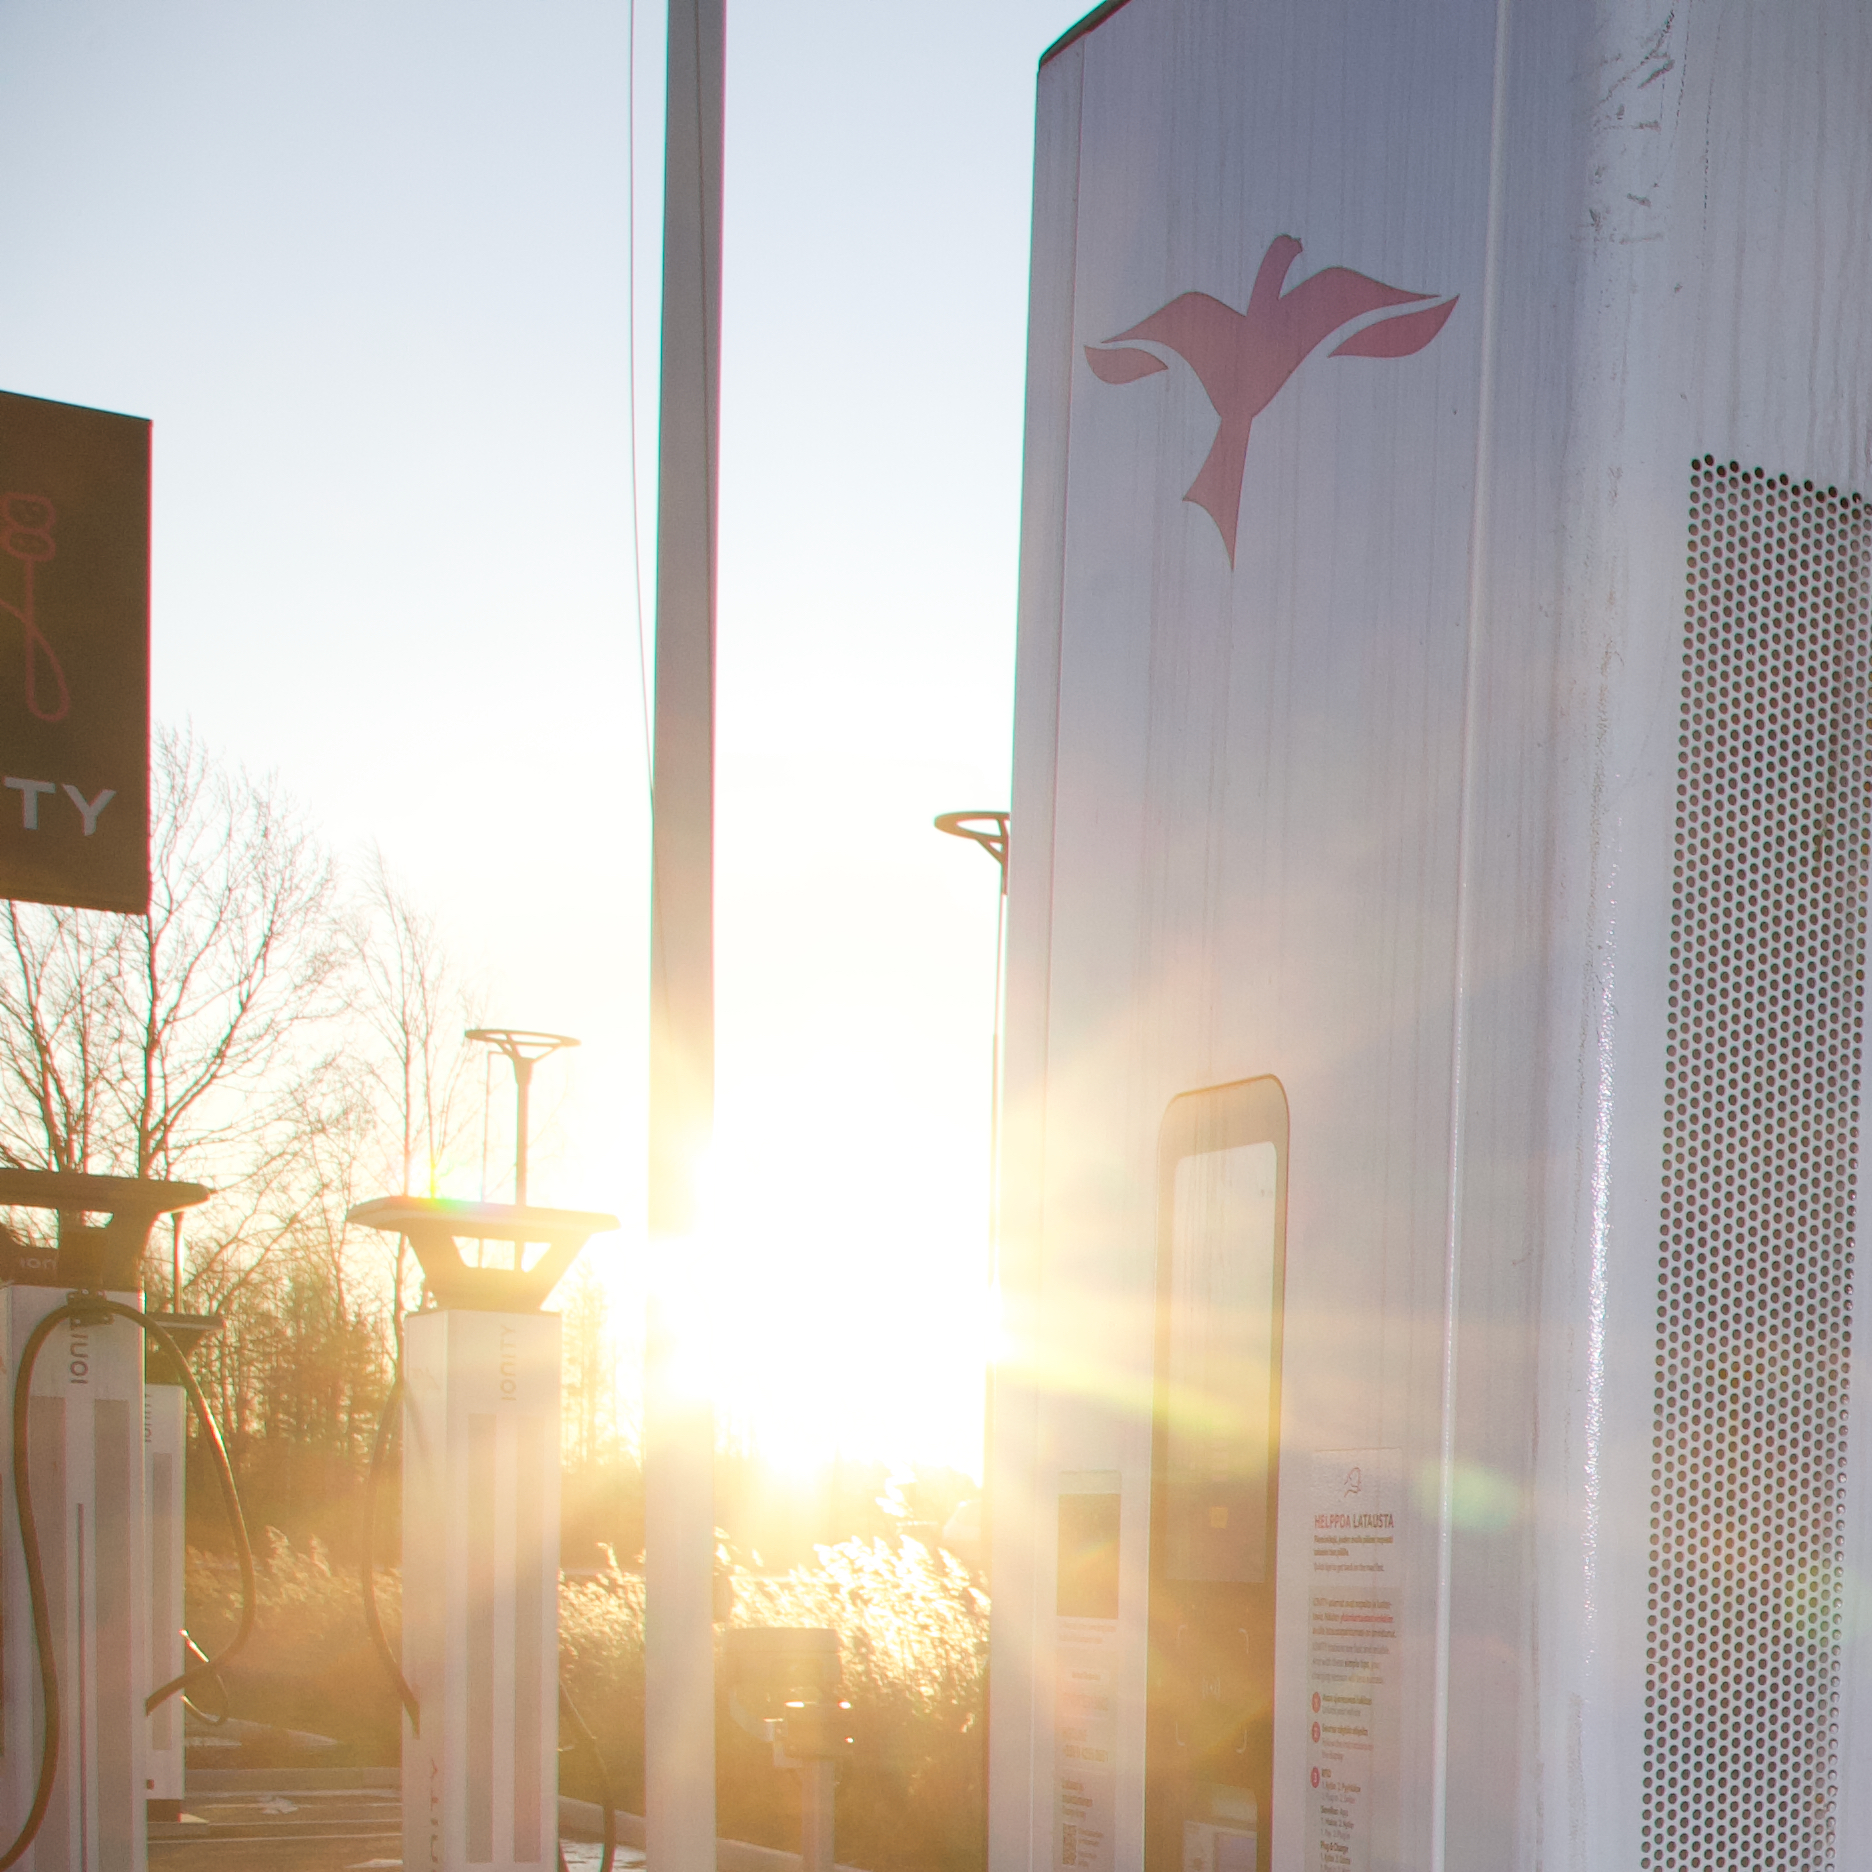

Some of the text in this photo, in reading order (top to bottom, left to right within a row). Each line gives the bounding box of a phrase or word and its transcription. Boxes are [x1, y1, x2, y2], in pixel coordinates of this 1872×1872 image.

[3, 776, 117, 837] TY
[1314, 1513, 1395, 1529] HELPPOA LATAUSTA
